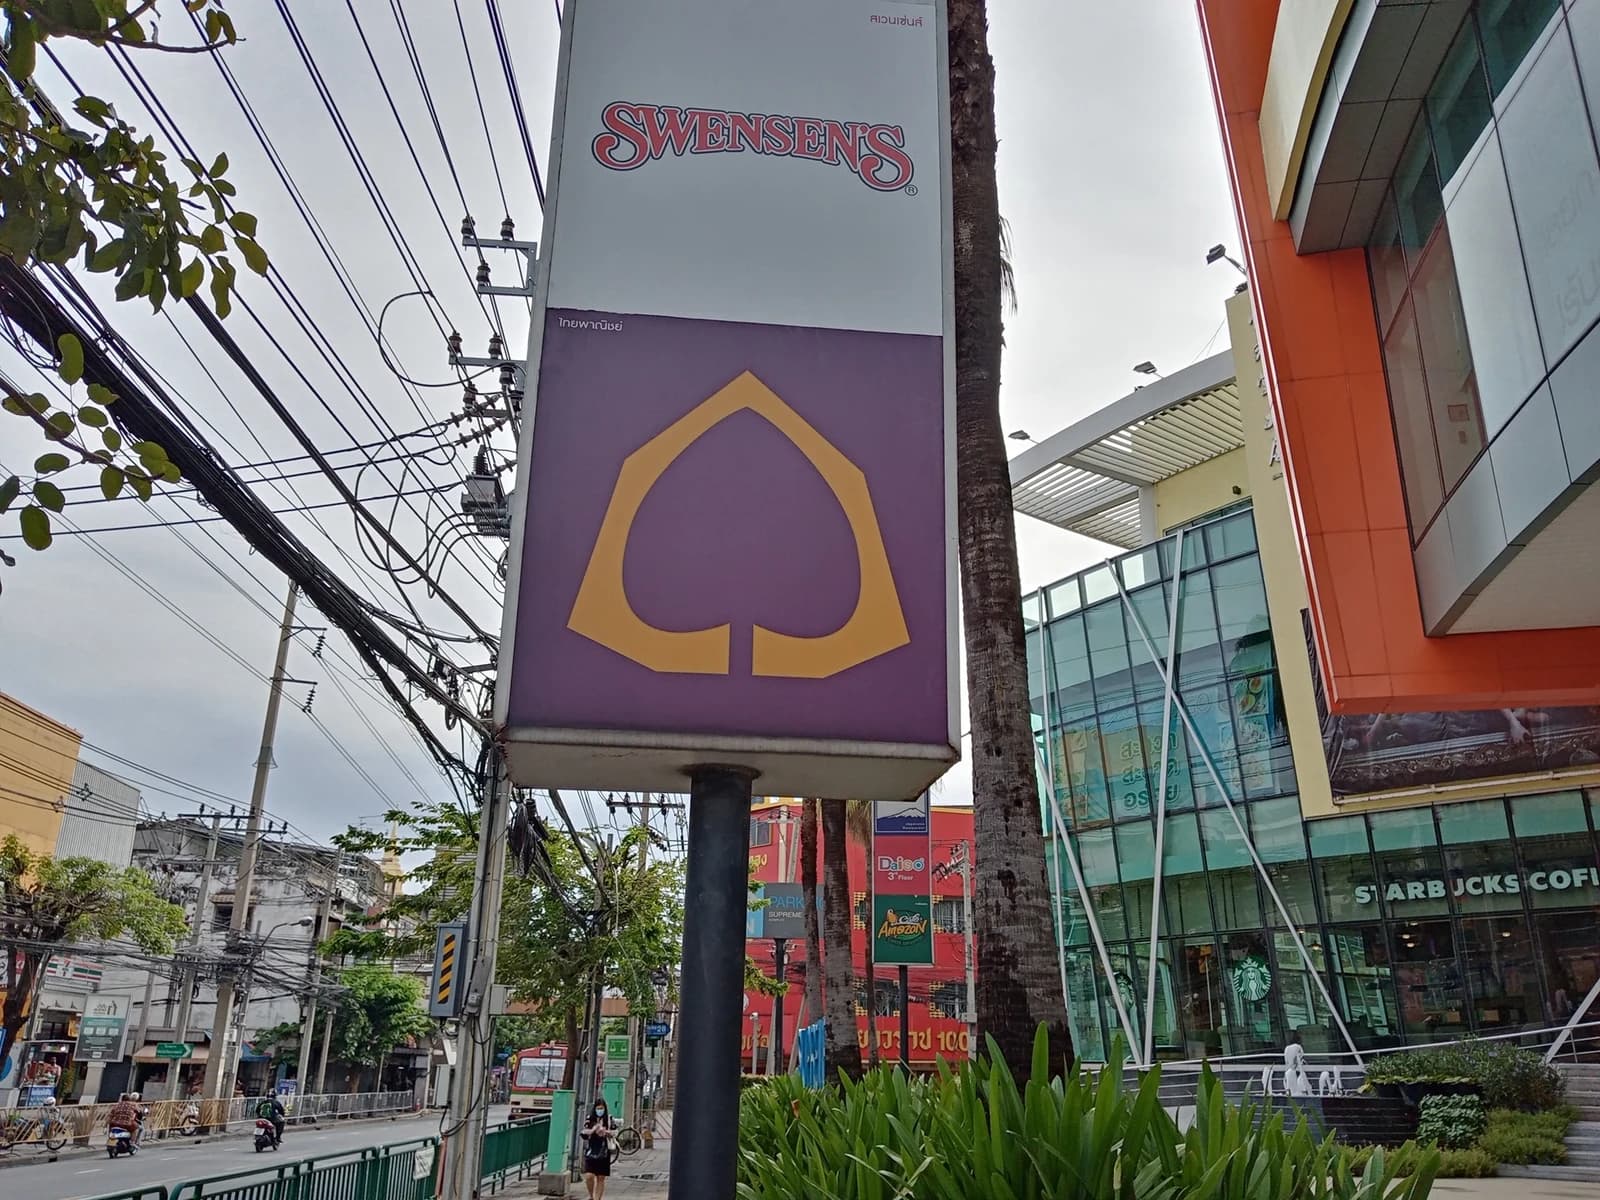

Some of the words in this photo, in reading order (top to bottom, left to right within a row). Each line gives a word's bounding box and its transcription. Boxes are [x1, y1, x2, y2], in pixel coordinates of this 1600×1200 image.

[870, 15, 924, 28] สเวนเซ่นส์
[592, 101, 914, 191] SWENSEN'S
[559, 317, 624, 331] ไทยพาณิชย์
[1120, 732, 1178, 761] สะวก
[877, 855, 925, 872] Daiso
